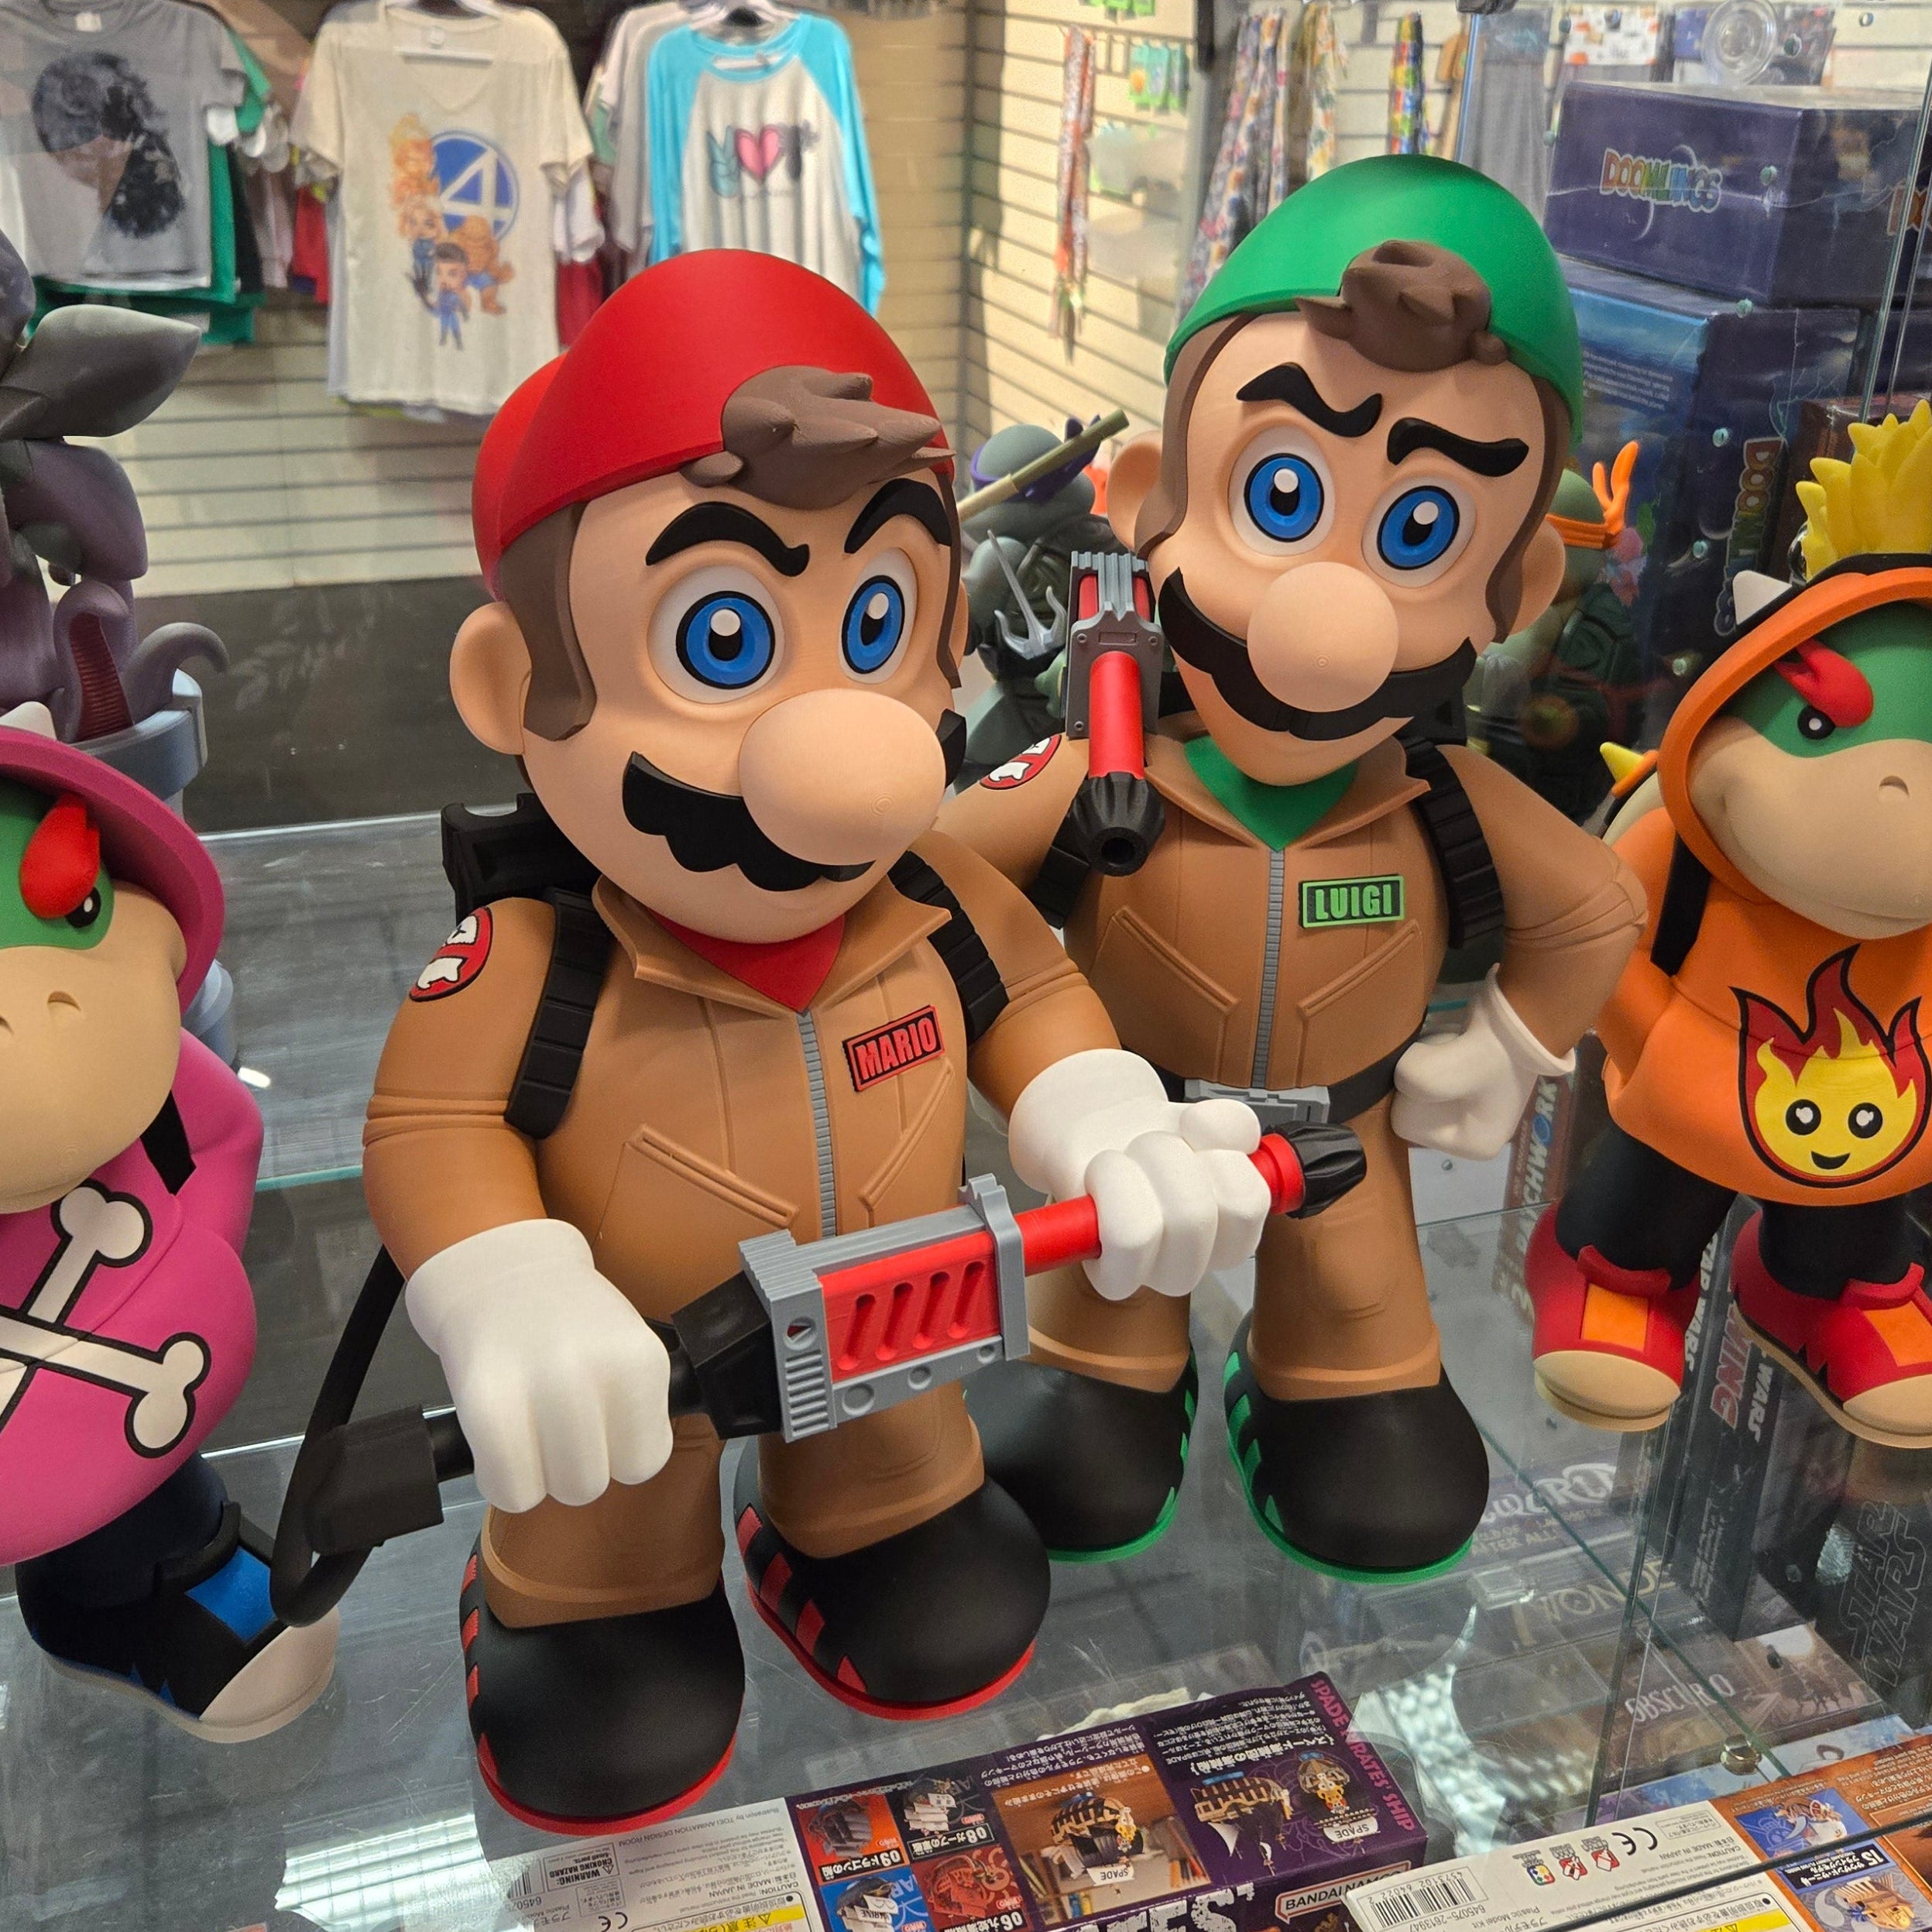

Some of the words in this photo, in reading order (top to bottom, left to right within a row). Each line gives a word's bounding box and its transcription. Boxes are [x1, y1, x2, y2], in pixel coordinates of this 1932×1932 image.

[1601, 149, 1721, 213] DOOMLINGS
[1714, 438, 1786, 637] DOOMLIGS
[1315, 884, 1392, 920] LUIGI
[854, 1017, 937, 1080] MARIO
[1687, 1300, 1707, 1372] WARS
[1748, 1361, 1774, 1444] WARS
[1838, 1499, 1899, 1659] STAR
[1863, 1514, 1927, 1687] WARS
[1625, 1673, 1737, 1723] OBSCURO
[1309, 1677, 1350, 1728] SPADE
[1381, 1792, 1416, 1834] SHIP
[643, 1829, 673, 1841] DESIGN
[674, 1820, 715, 1834] ANIMATION
[964, 1826, 987, 1841] 08
[1334, 1823, 1371, 1839] SPADE
[1659, 1849, 1681, 1860] JAPAN
[1693, 1841, 1713, 1852] MADE
[1706, 1844, 1741, 1858] CAUTION:
[578, 1857, 613, 1871] CHOKING
[879, 1849, 901, 1867] 09
[1860, 1847, 1884, 1867] 15
[549, 1865, 578, 1878] HAZARD
[821, 1855, 880, 1878] ドラゴンの船
[1100, 1868, 1128, 1881] SPADE
[555, 1869, 600, 1886] WARNING:
[746, 1878, 770, 1889] MADE
[709, 1886, 735, 1897] JAPAN
[758, 1880, 798, 1895] CAUTION:
[1379, 1883, 1412, 1899] 64022
[1285, 1888, 1343, 1911] BANDAI
[1000, 1910, 1024, 1930] 06
[1485, 1913, 1510, 1926] Model
[1510, 1905, 1540, 1920] Plastic
[1471, 1919, 1485, 1930] Kit
